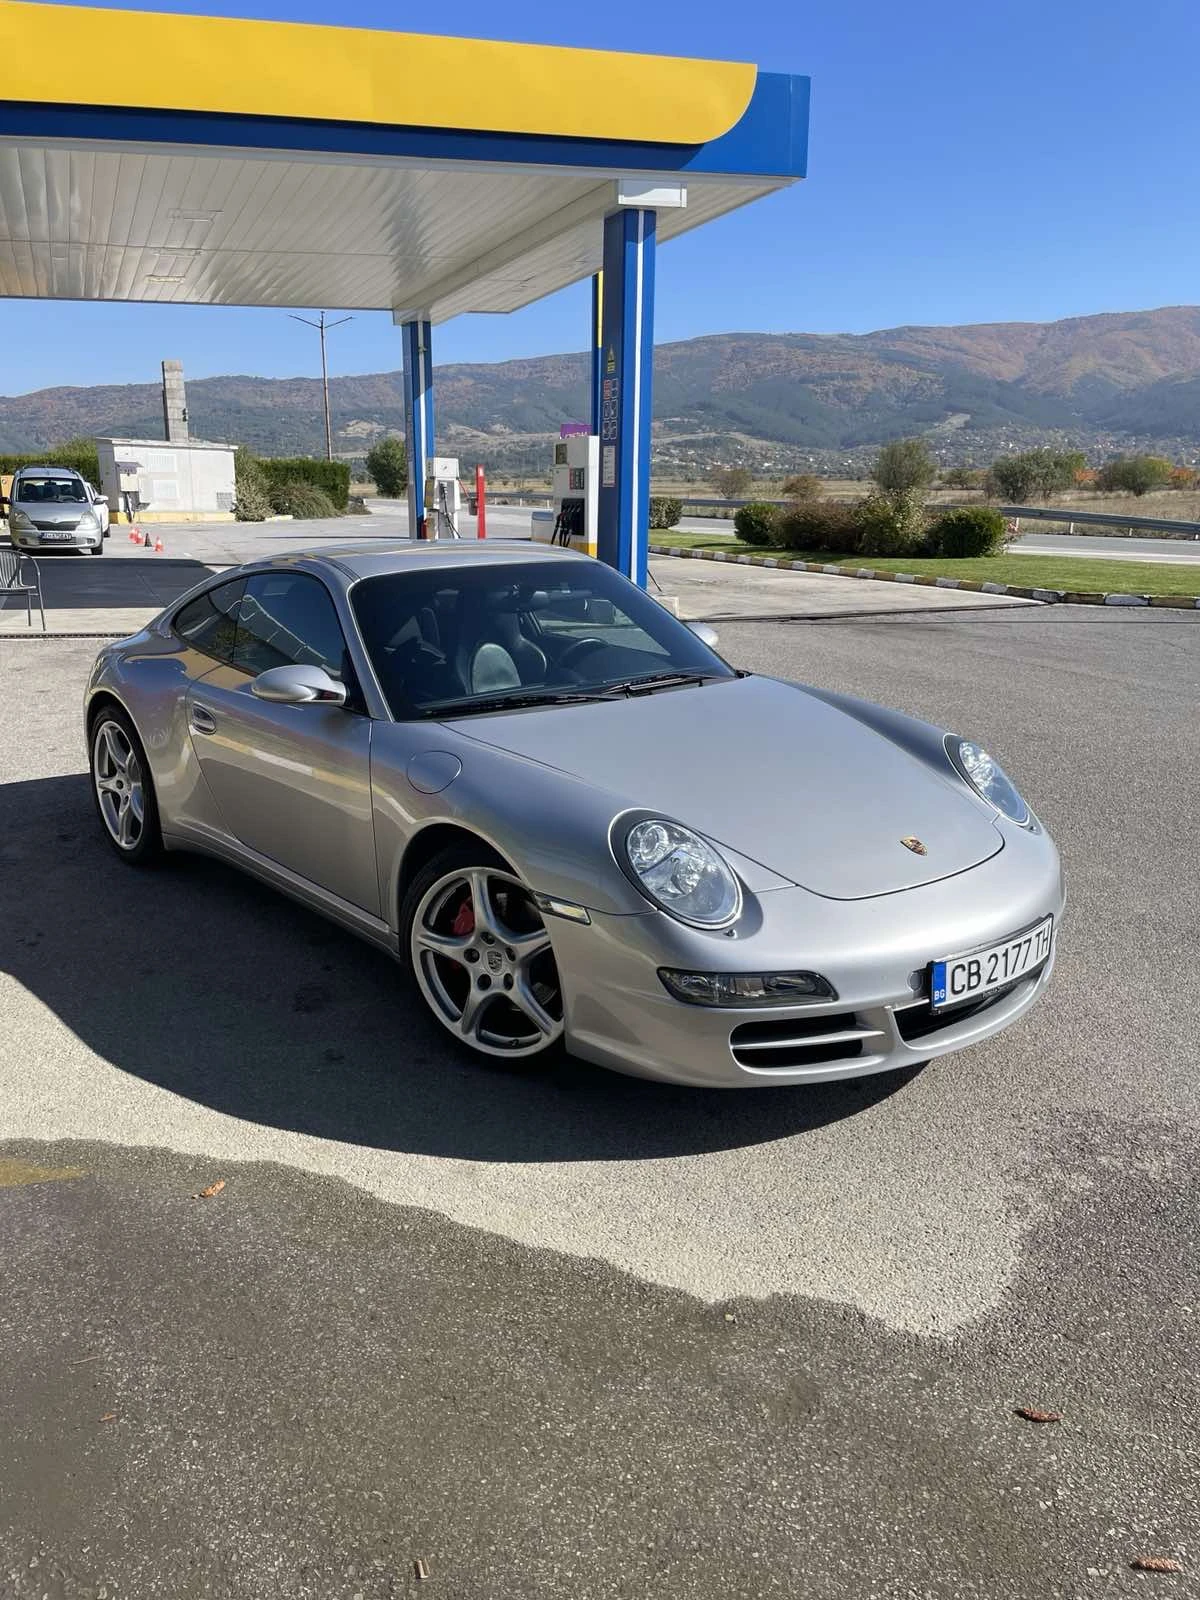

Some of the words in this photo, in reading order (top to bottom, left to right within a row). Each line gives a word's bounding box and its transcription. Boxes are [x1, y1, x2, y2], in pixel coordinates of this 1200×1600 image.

[951, 959, 982, 995] CB
[987, 938, 1032, 985] 2177
[1035, 924, 1050, 960] TH
[934, 989, 945, 1000] BG
